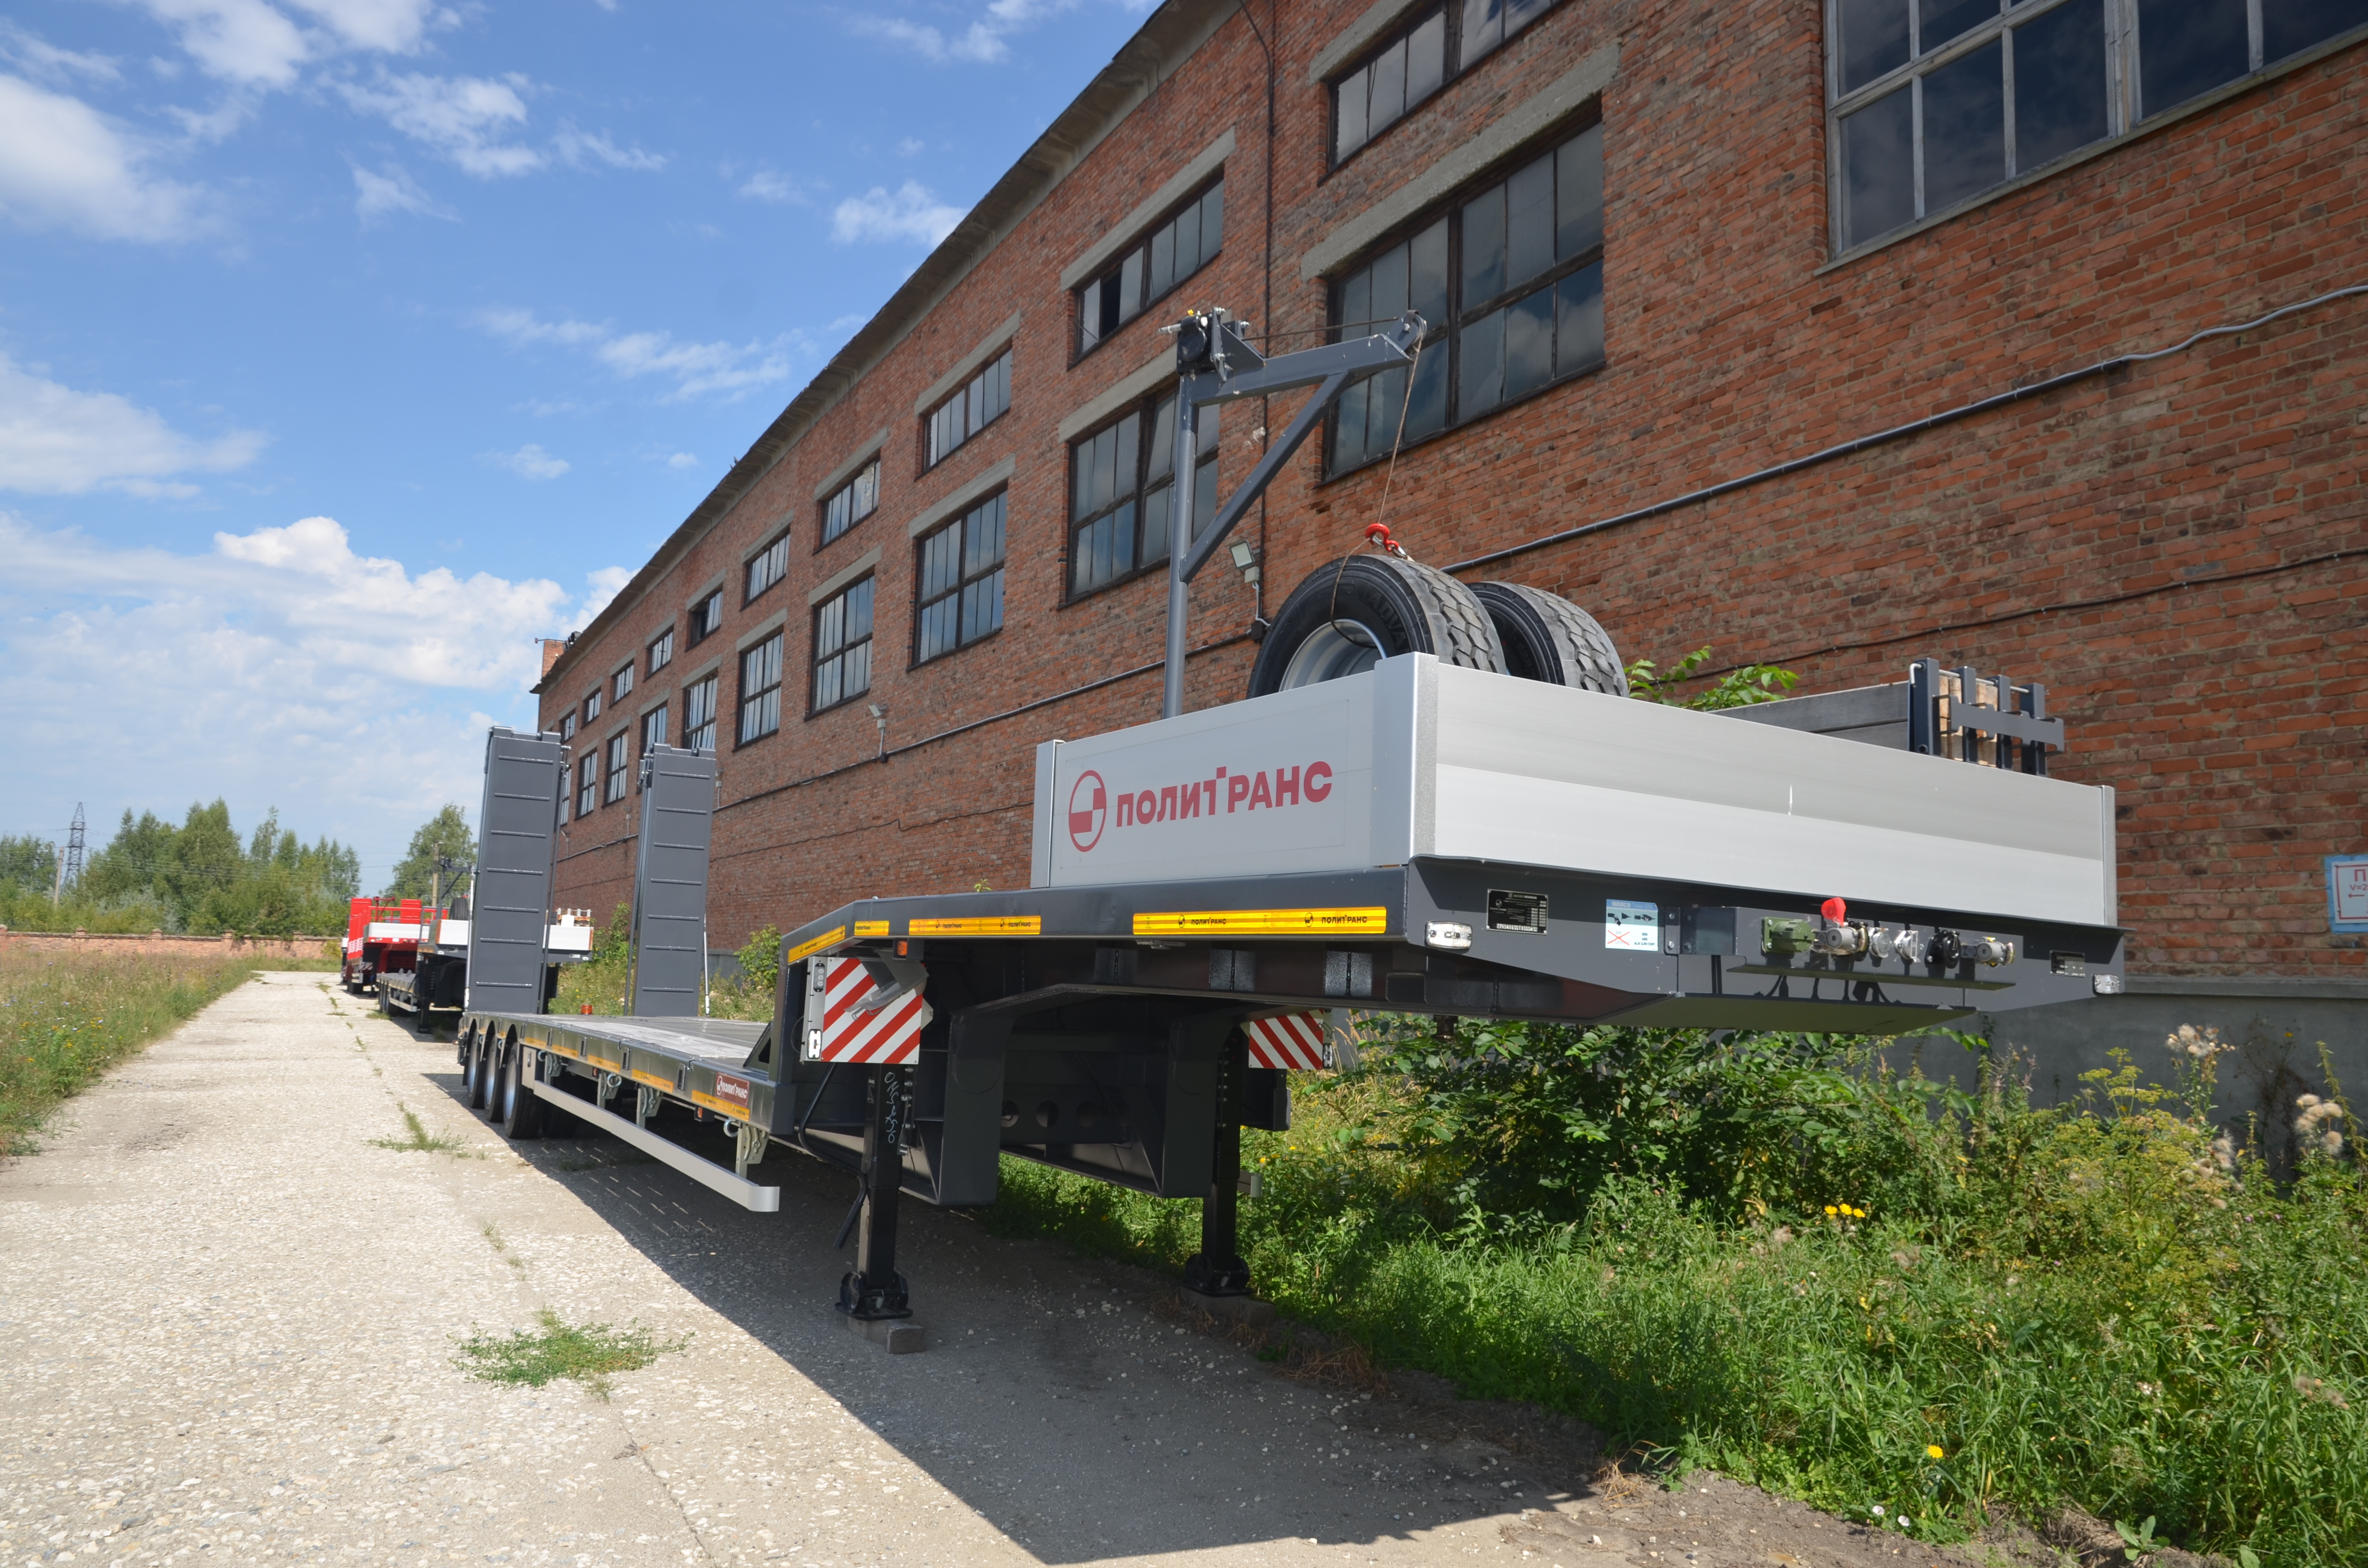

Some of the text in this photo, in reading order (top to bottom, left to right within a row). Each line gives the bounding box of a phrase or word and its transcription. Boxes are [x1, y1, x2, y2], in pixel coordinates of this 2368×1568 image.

[1116, 761, 1332, 827] ПОЛИТРАНС
[1191, 917, 1226, 925] ПОЛИТРАНС
[1321, 915, 1368, 924] ПОЛИТРАНС
[722, 1082, 748, 1099] ПОЛИТРАНС
